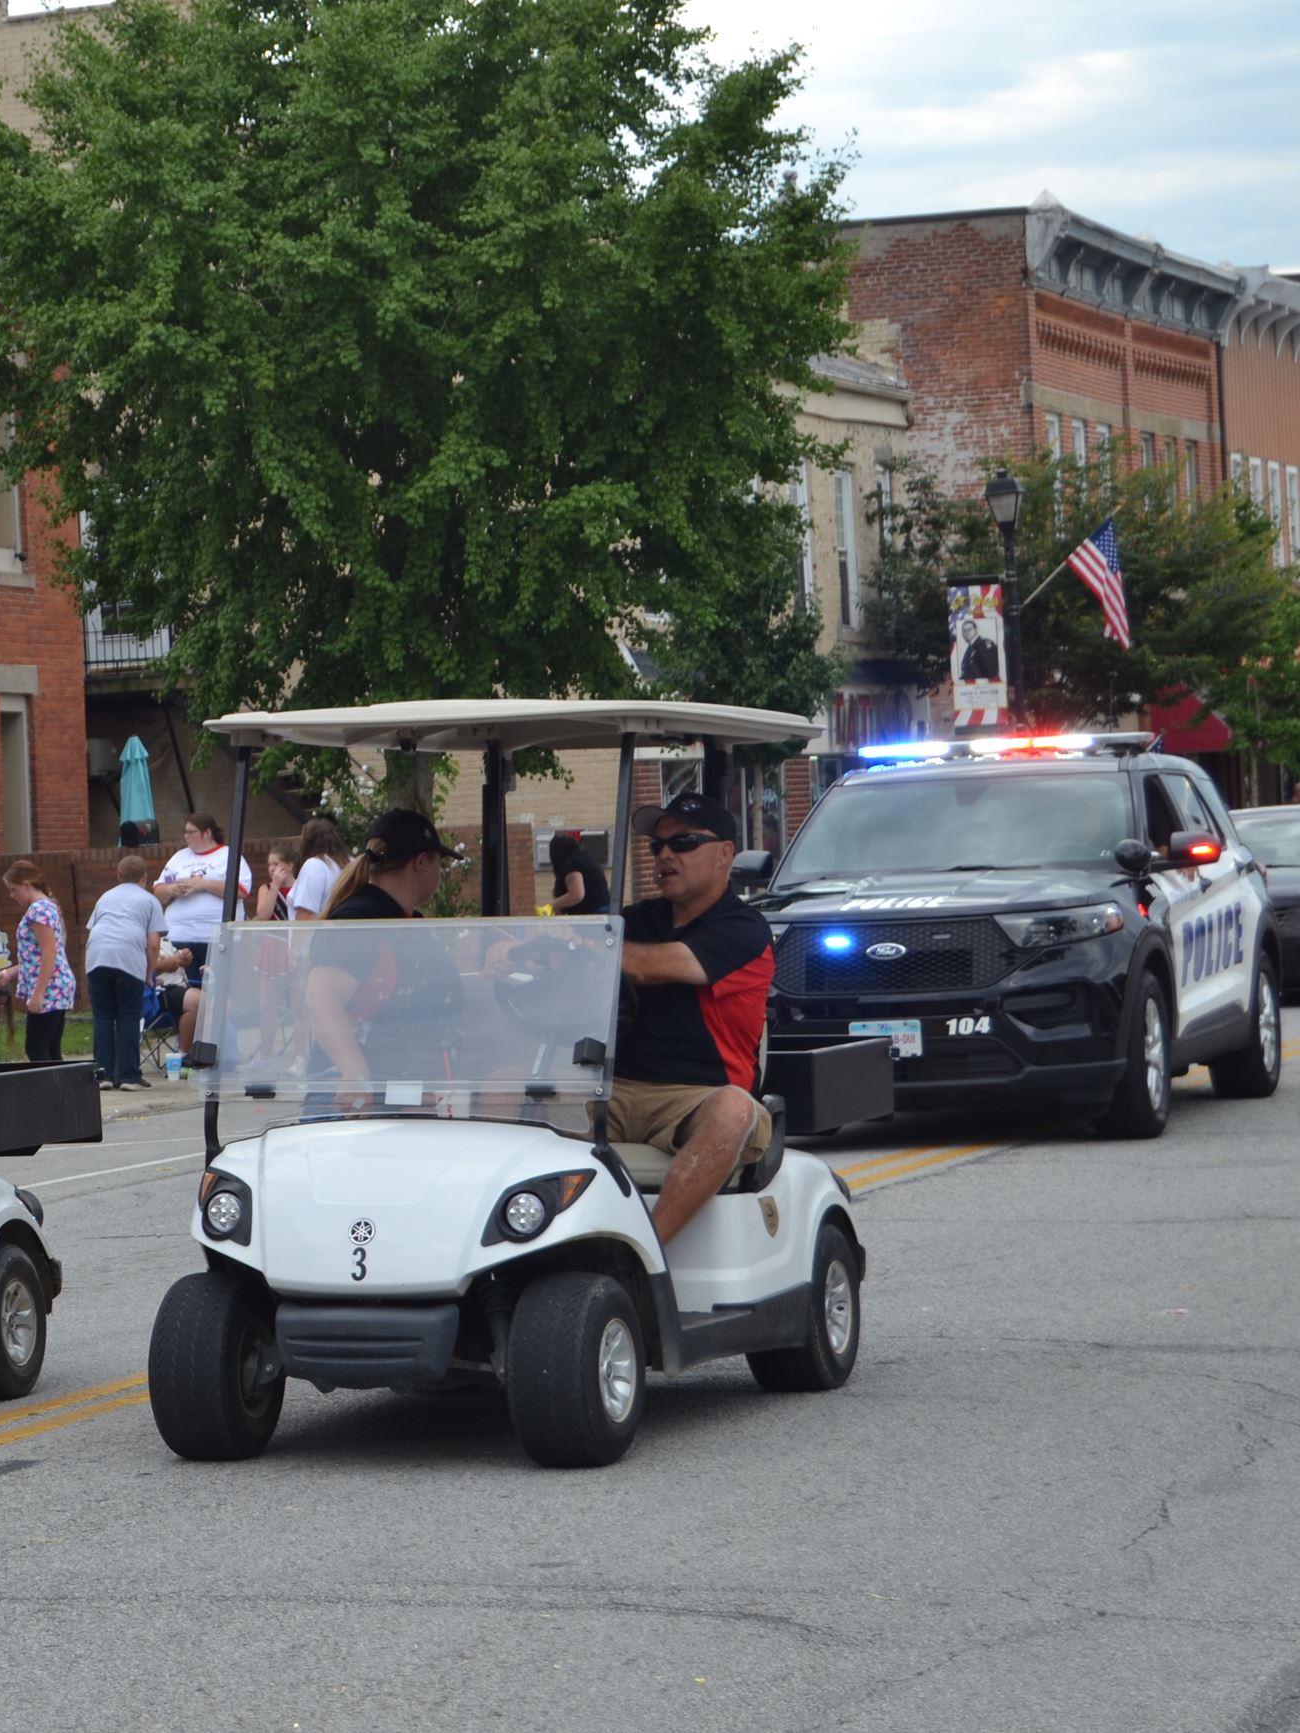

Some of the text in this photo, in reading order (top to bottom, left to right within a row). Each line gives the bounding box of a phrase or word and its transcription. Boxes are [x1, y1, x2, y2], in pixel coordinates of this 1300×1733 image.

[840, 896, 947, 911] POLICE
[1181, 901, 1244, 989] POLICE
[946, 1016, 990, 1036] 104
[351, 1246, 367, 1281] 3
